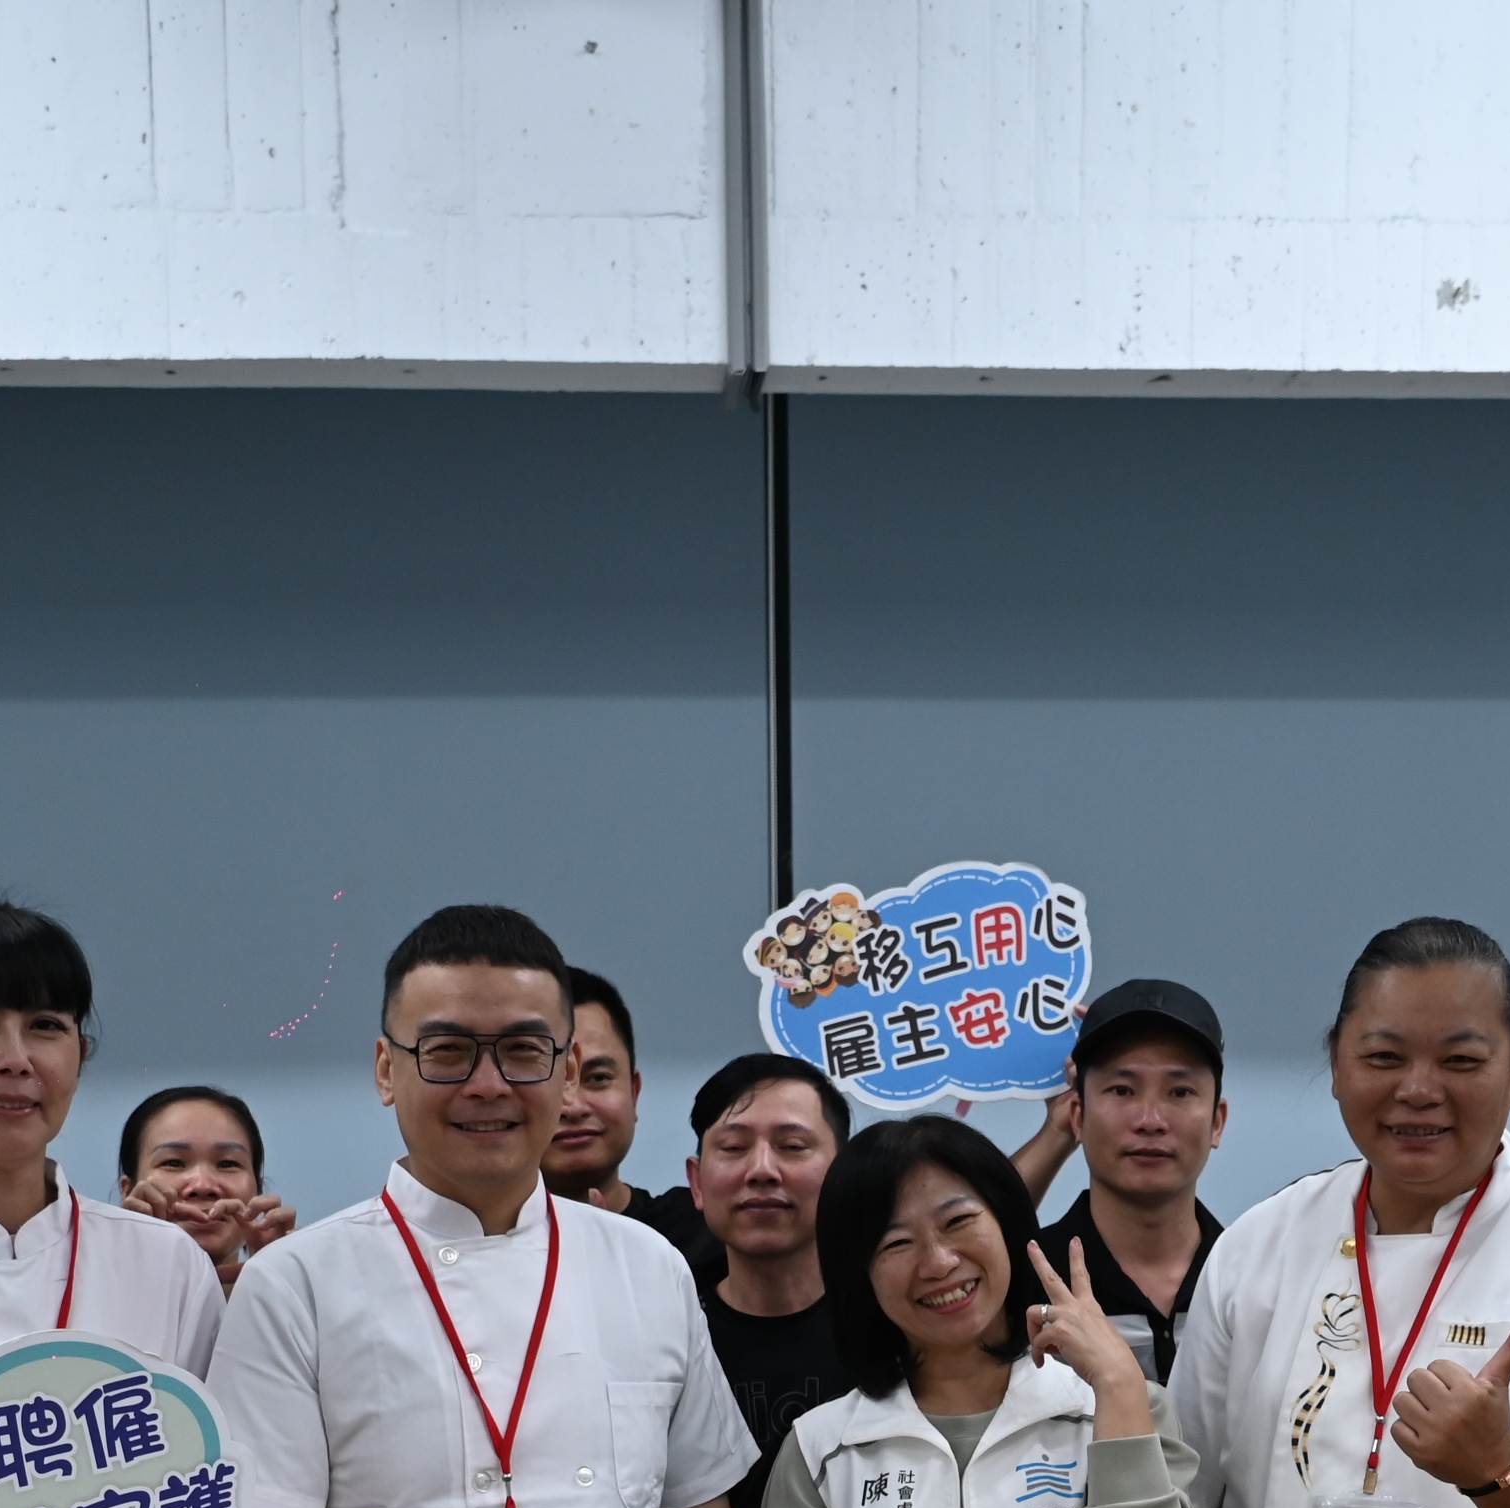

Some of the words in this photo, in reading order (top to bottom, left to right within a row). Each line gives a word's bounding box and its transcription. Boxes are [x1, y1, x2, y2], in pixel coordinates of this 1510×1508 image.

[857, 895, 1081, 992] 移工用心
[824, 978, 1070, 1078] 雇主安心
